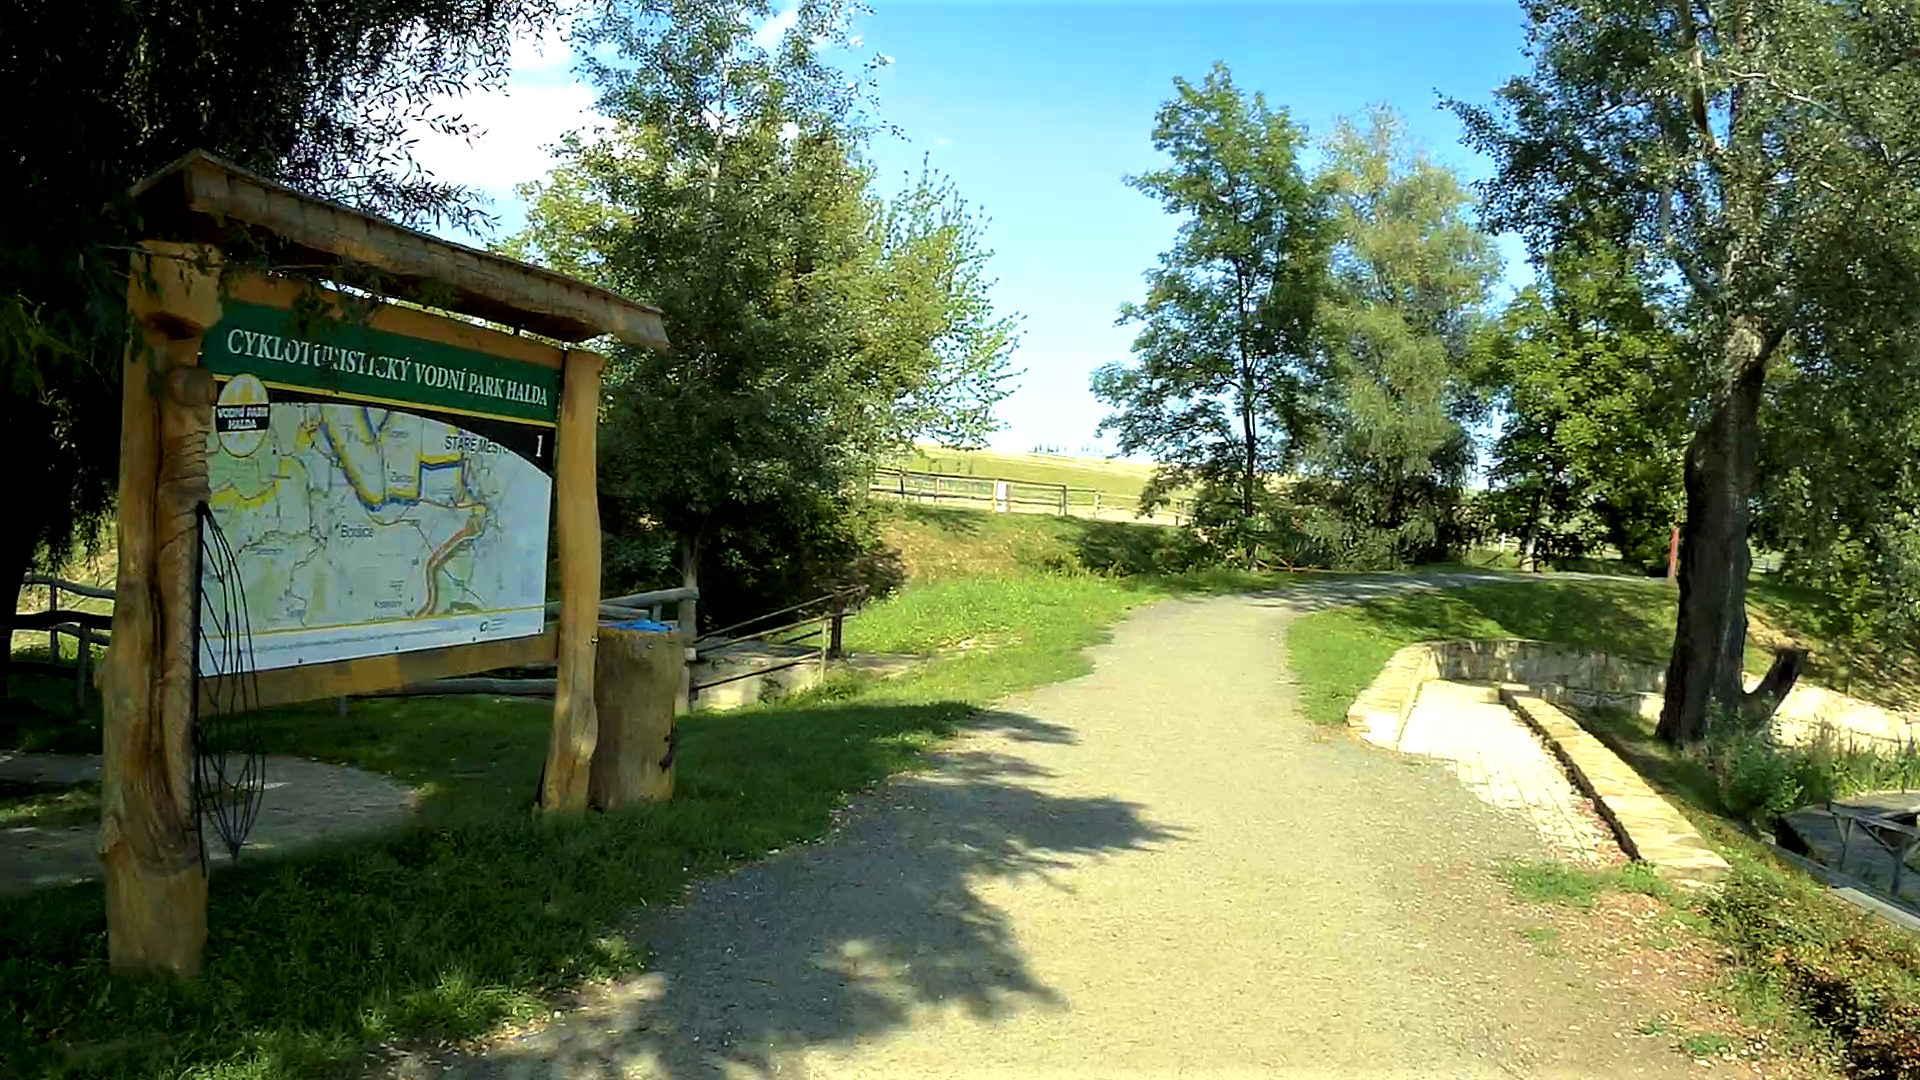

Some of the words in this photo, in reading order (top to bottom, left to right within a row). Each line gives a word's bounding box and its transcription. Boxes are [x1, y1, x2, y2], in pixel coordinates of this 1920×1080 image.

[415, 362, 467, 392] VODNÍ
[467, 372, 505, 399] PARK
[505, 380, 548, 406] HALDA
[535, 434, 544, 457] 1
